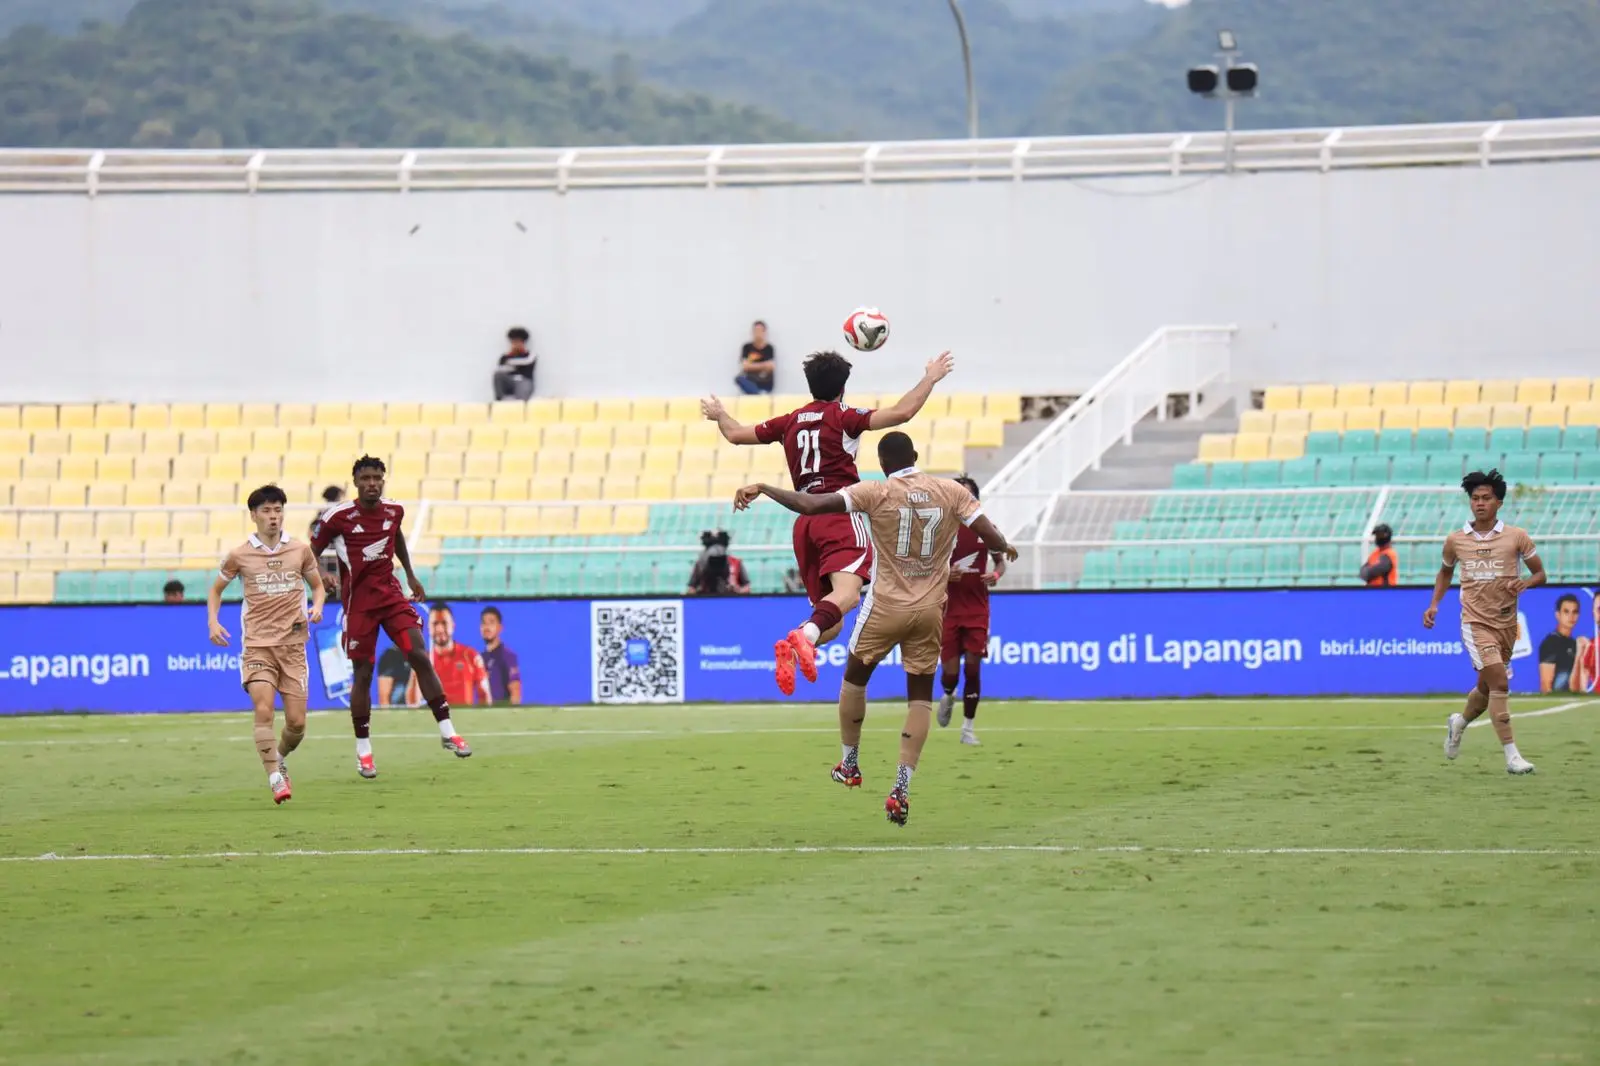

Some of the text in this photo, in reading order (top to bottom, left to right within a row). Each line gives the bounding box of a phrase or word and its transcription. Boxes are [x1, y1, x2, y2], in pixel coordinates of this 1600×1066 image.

[796, 429, 821, 476] 21
[895, 506, 943, 558] 17
[255, 570, 297, 584] BAIC
[1464, 559, 1505, 570] BAIC
[1107, 633, 1137, 663] di
[1145, 633, 1302, 670] Lapangan
[1320, 639, 1463, 657] bbri.id/cicilemas
